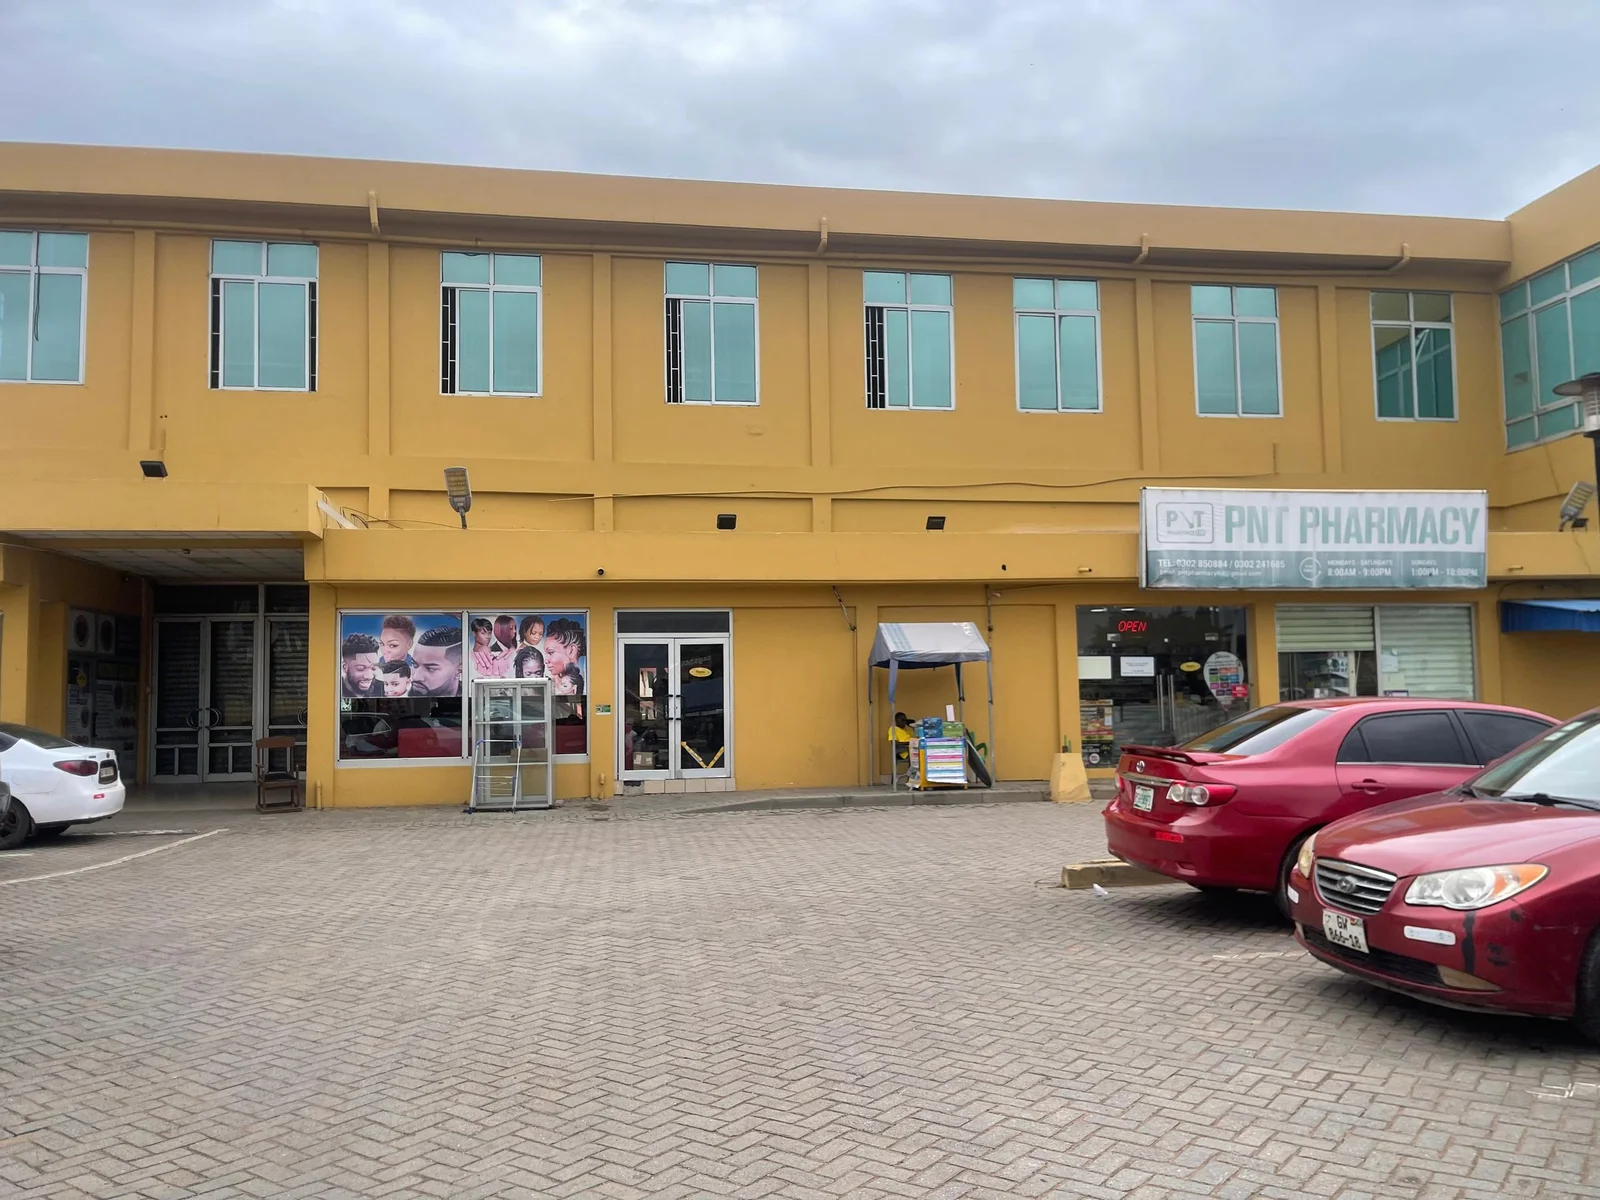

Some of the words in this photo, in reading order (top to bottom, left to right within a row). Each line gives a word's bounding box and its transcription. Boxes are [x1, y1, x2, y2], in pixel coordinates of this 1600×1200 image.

[1225, 505, 1289, 543] PNT
[1300, 506, 1480, 545] PHARMACY
[1157, 559, 1175, 568] TEL:
[1176, 559, 1196, 568] 0302
[1234, 560, 1254, 568] 0302
[1118, 620, 1147, 632] OPEN
